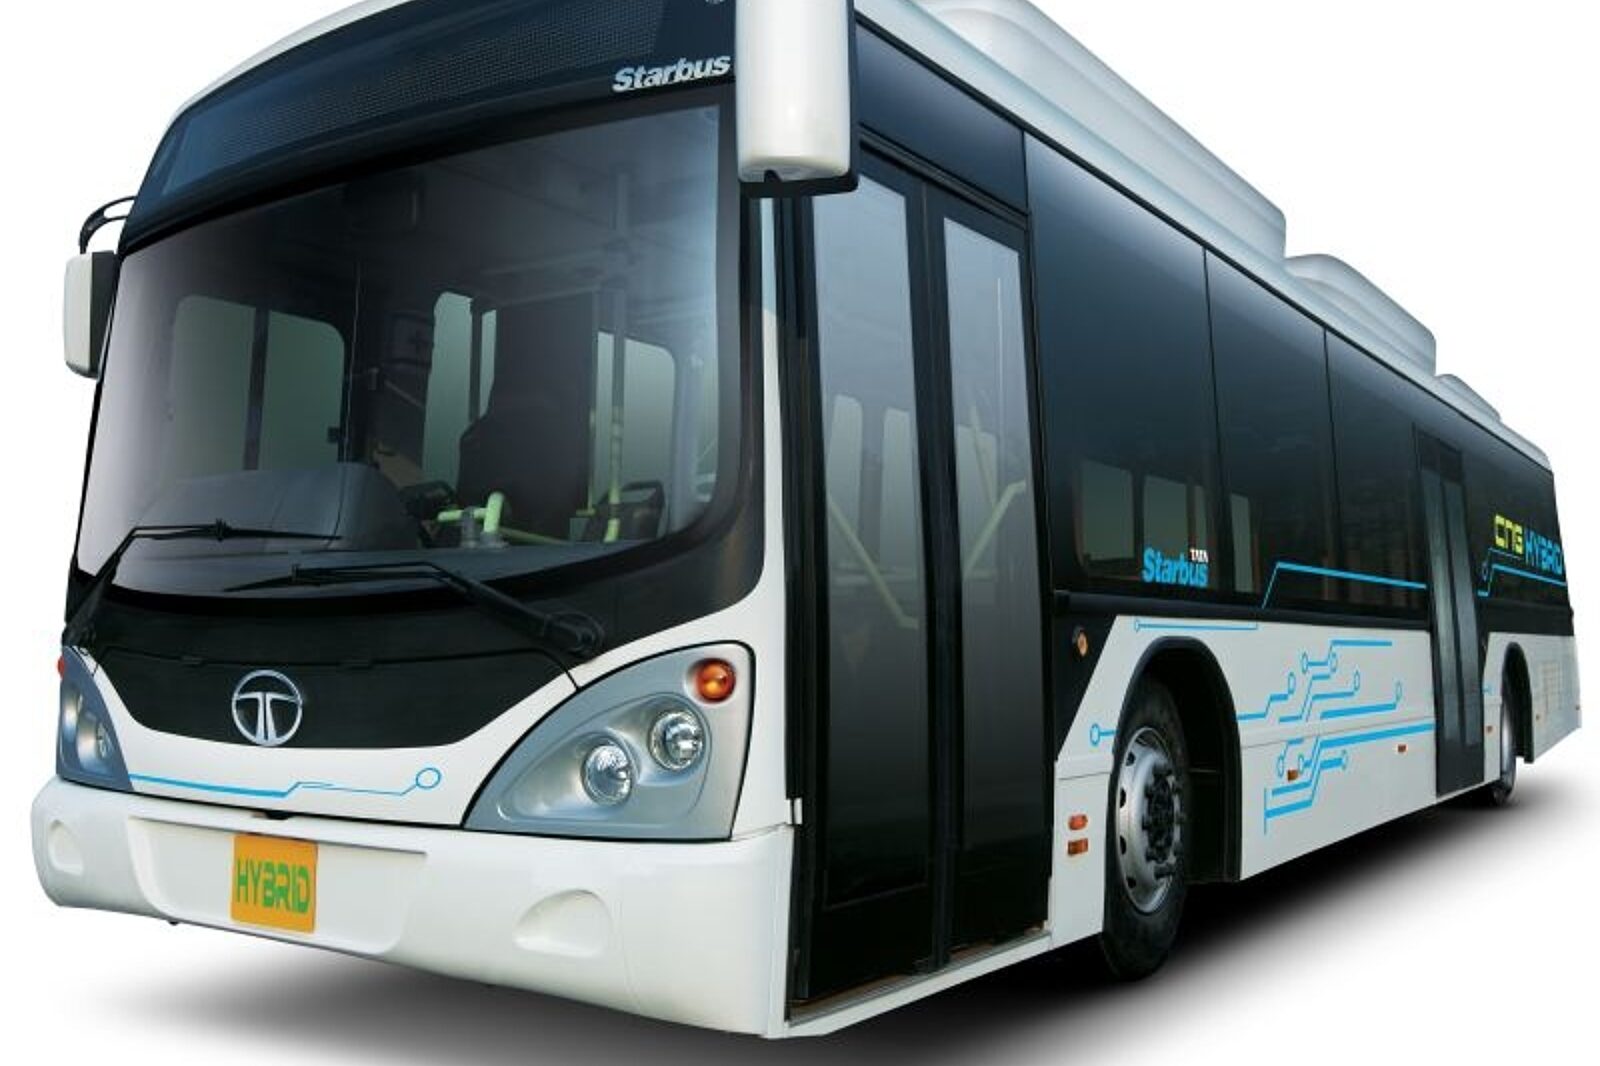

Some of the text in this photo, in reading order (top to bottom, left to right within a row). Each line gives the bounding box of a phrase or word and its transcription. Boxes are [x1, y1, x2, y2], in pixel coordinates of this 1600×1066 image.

[611, 54, 731, 93] Starbus
[1142, 547, 1208, 588] Starbus
[1525, 527, 1563, 576] HYBRID
[236, 857, 310, 914] HYBRID
